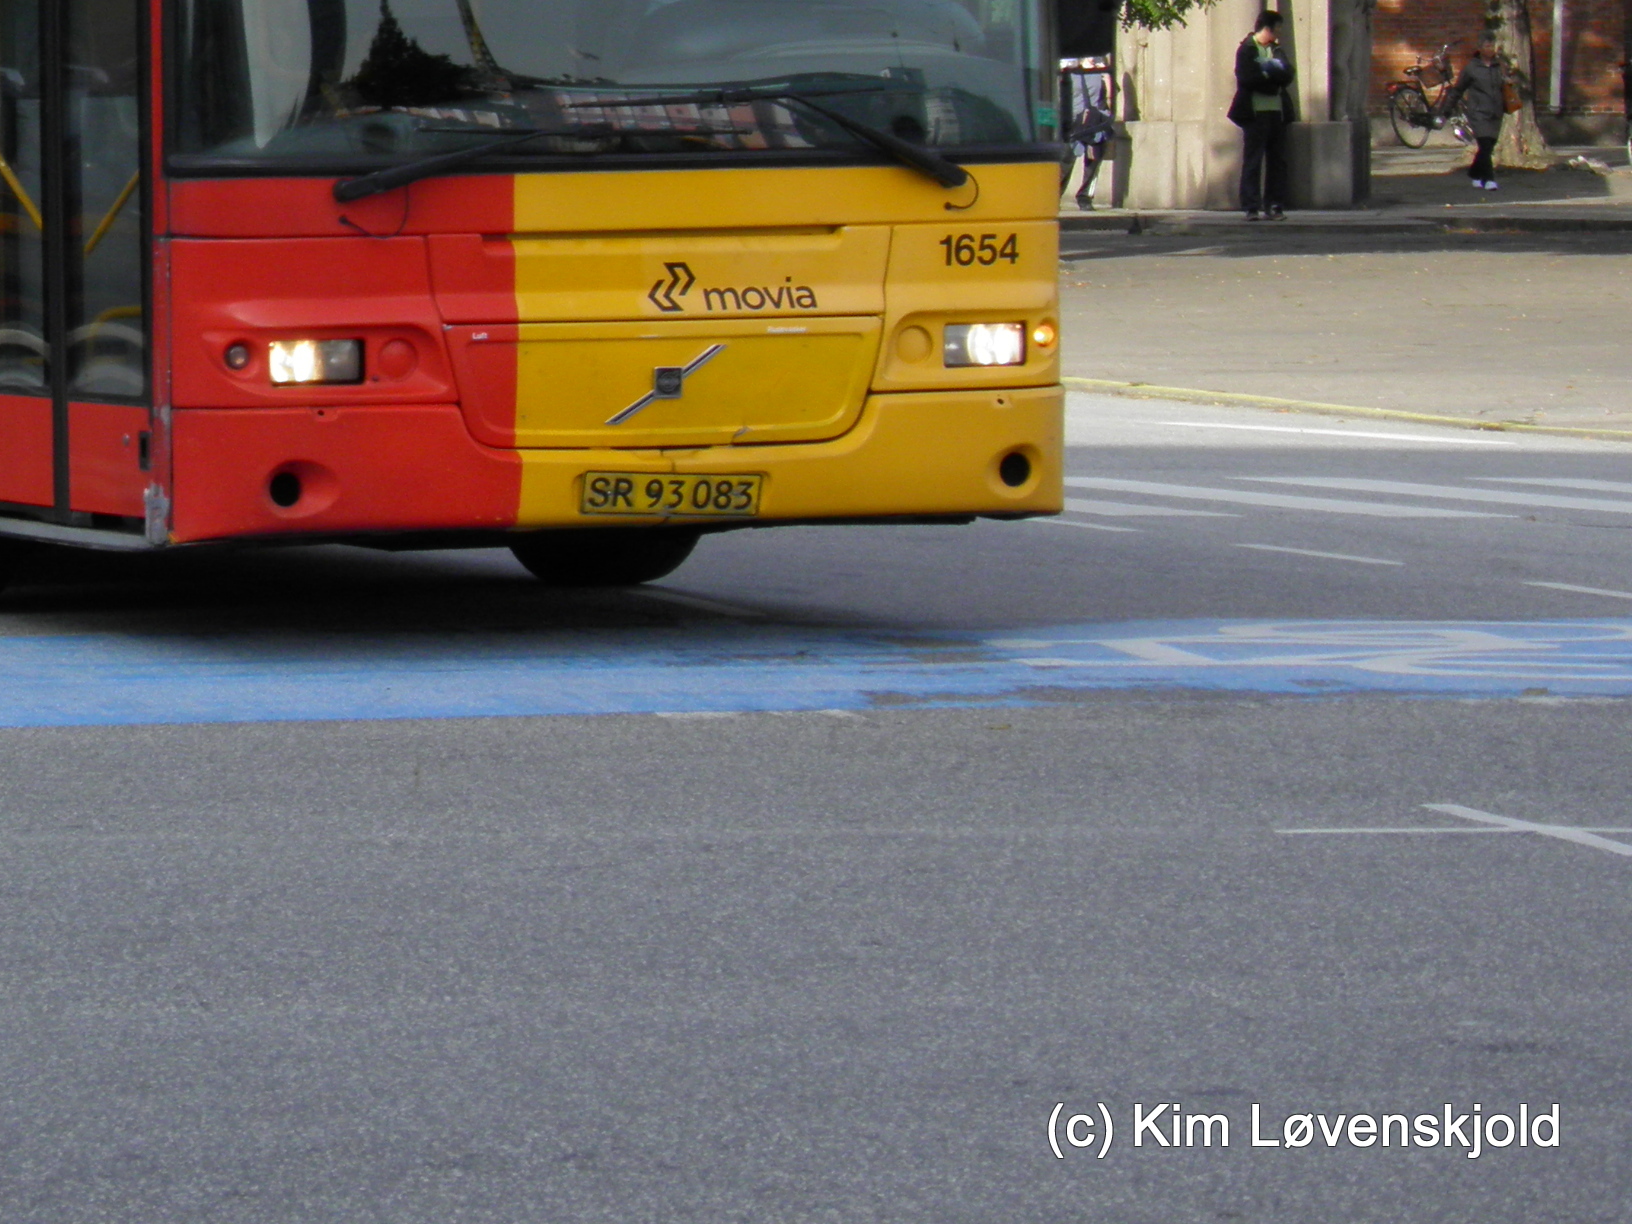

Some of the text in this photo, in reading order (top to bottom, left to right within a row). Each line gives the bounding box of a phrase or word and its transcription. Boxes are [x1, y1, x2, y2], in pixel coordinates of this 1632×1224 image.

[939, 232, 1020, 267] 1654
[703, 276, 817, 311] movia
[587, 477, 754, 512] SR 93 083
